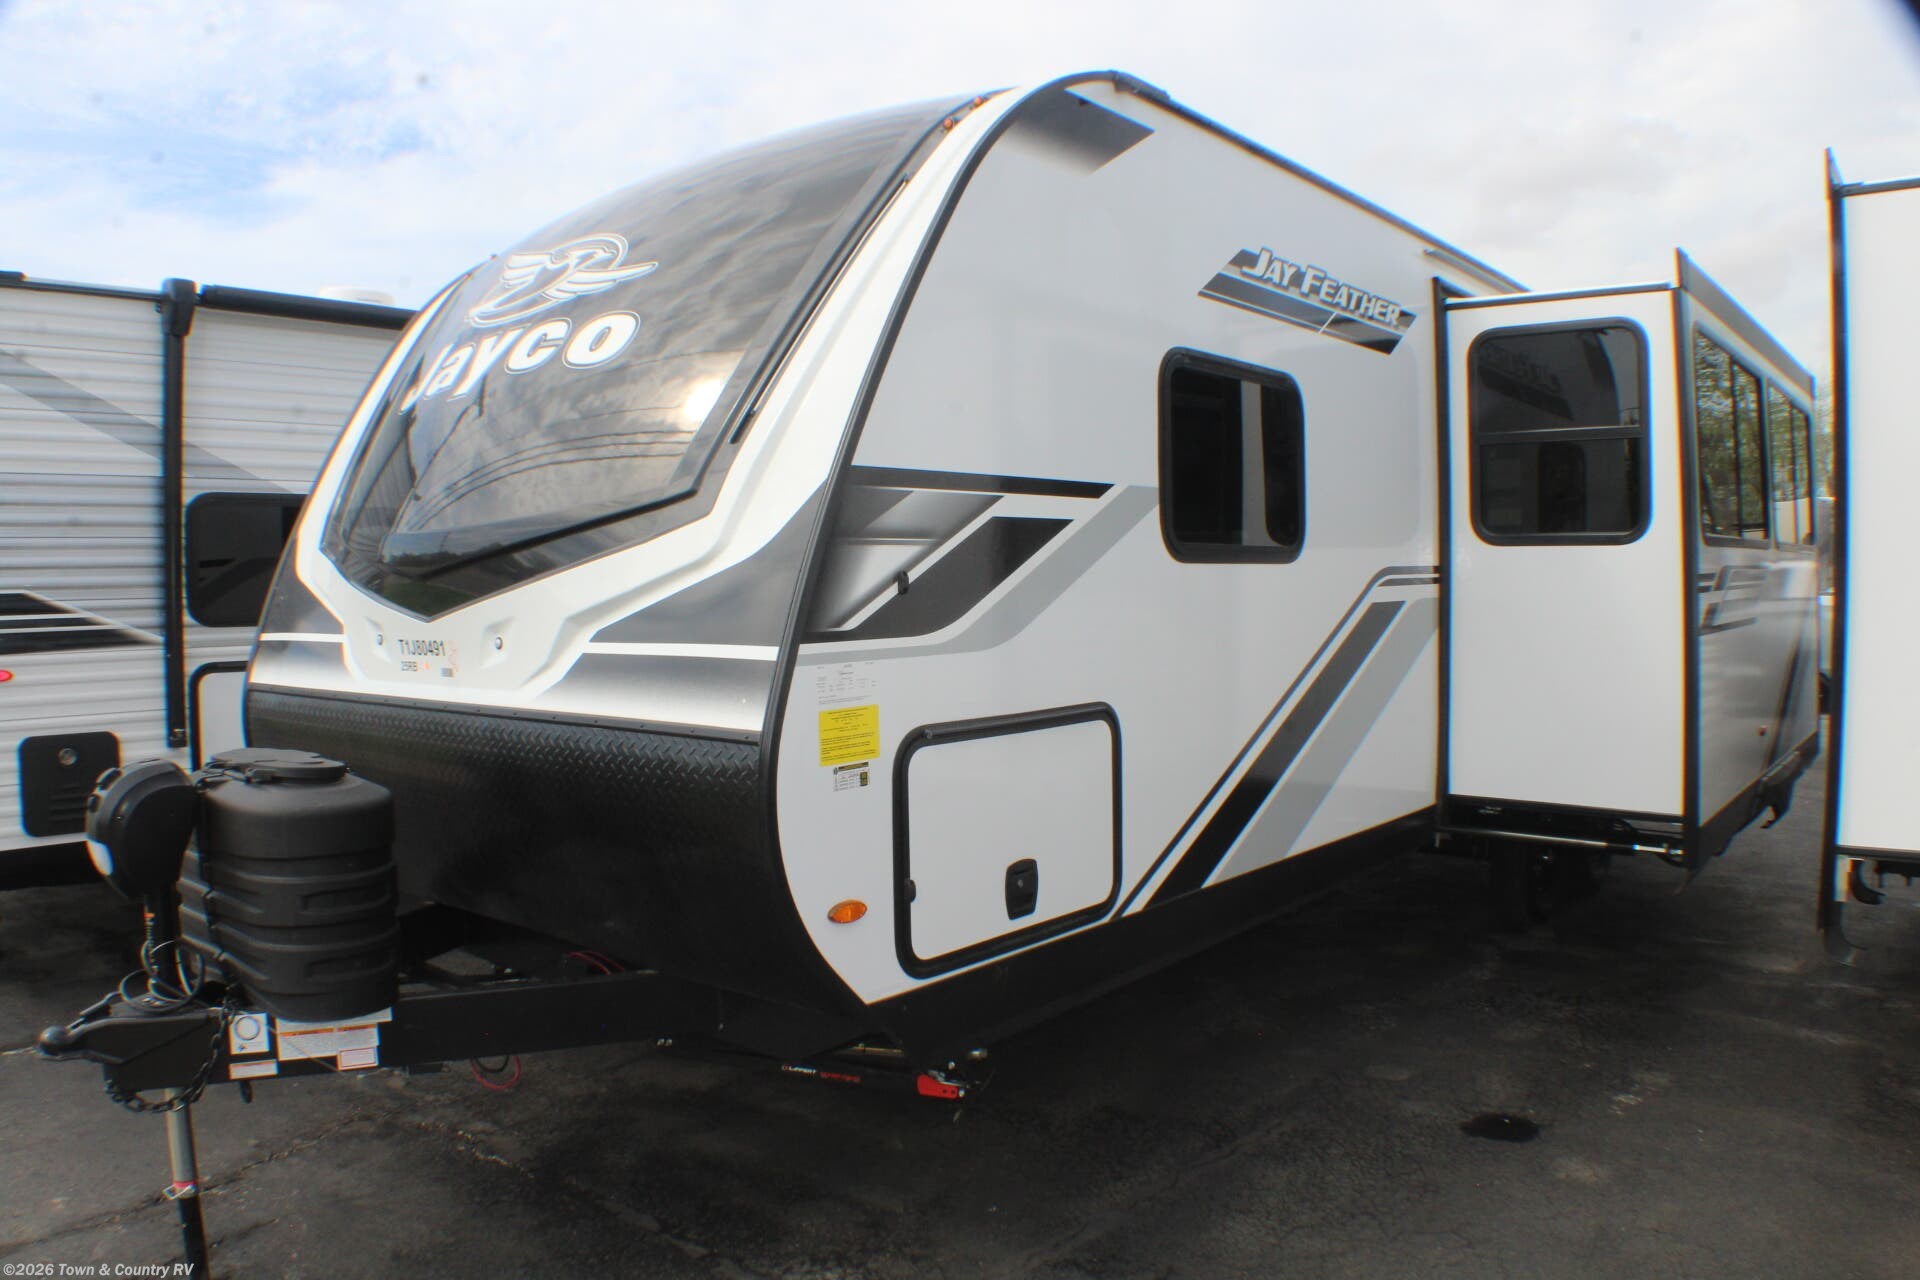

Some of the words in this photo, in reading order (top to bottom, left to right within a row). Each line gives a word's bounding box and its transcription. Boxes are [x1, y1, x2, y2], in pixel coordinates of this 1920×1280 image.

[1239, 245, 1299, 287] JAY
[1300, 264, 1402, 327] FEATHER
[398, 639, 446, 656] T1J80491
